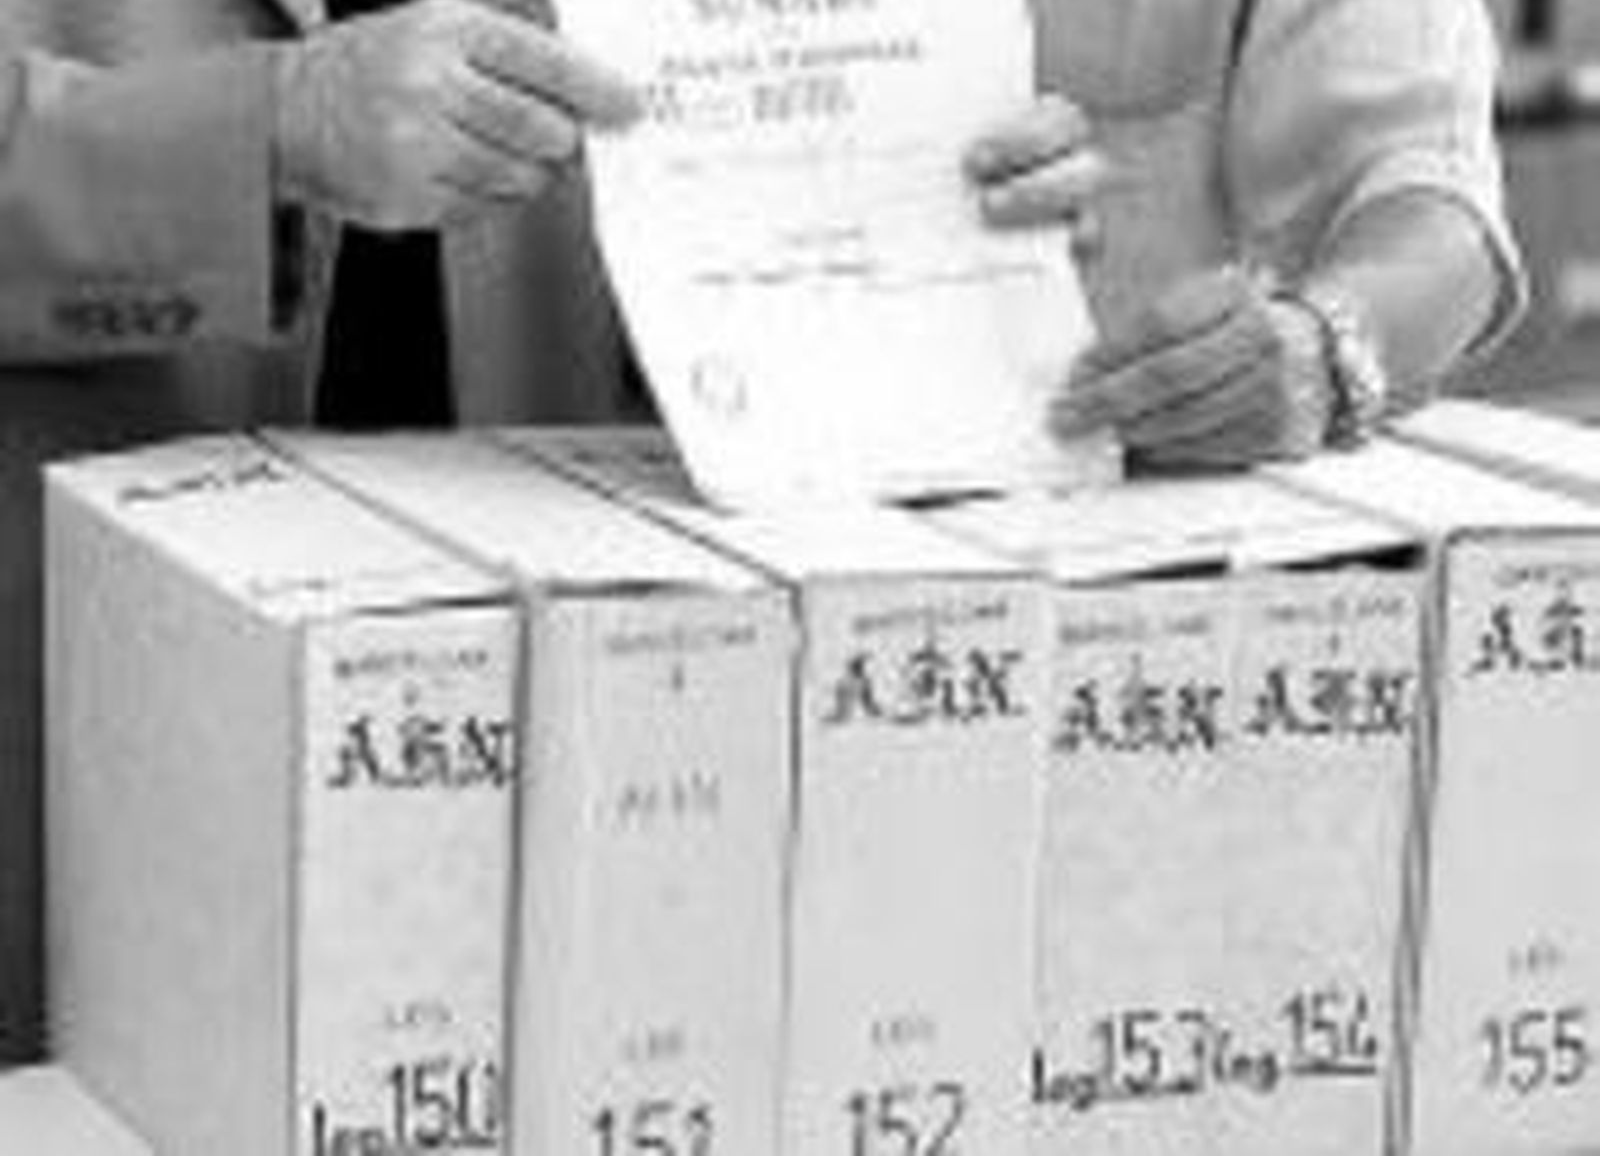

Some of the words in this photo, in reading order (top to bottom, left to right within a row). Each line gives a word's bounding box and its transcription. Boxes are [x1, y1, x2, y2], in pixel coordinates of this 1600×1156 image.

[1091, 1007, 1206, 1102] 153
[1478, 1006, 1590, 1096] 155
[844, 1080, 964, 1156] 152
